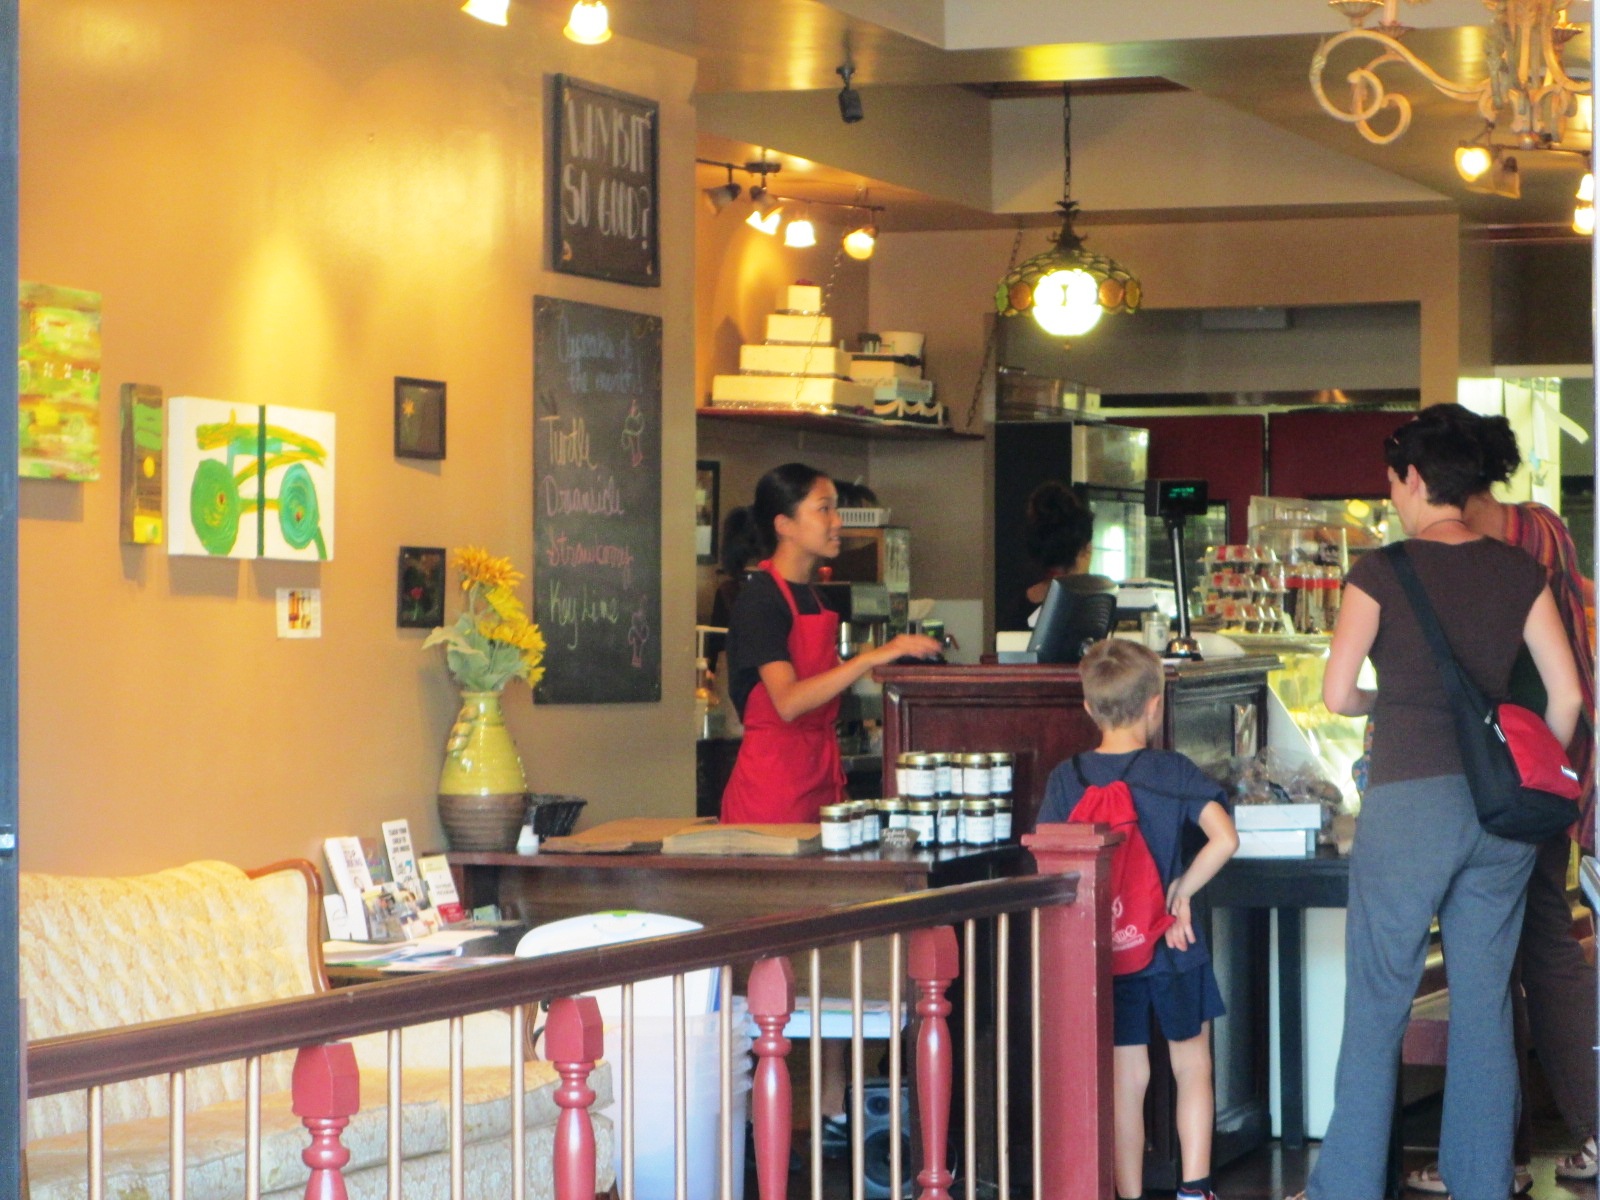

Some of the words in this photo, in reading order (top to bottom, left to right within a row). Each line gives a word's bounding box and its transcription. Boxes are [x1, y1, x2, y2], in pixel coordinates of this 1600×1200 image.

[562, 163, 591, 227] SO
[598, 177, 651, 250] GOOD?
[540, 415, 597, 470] Turtle
[549, 578, 579, 651] Key
